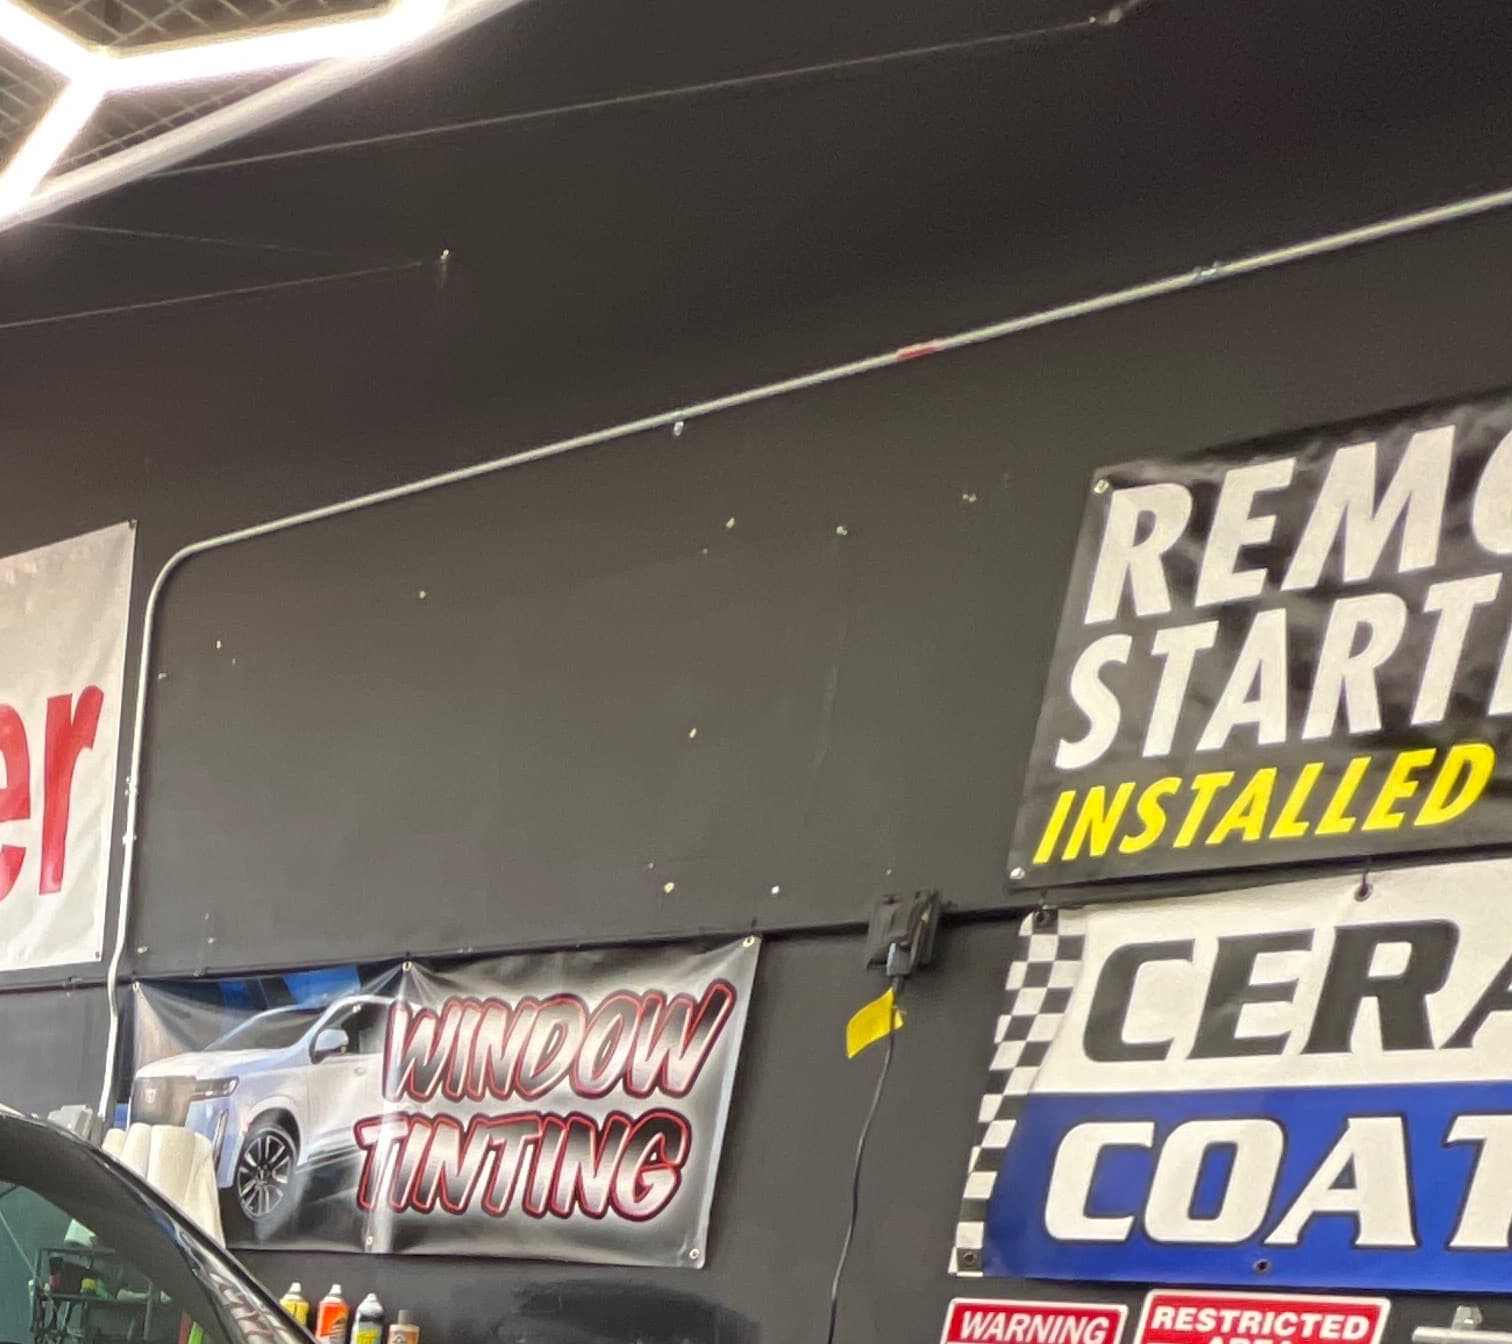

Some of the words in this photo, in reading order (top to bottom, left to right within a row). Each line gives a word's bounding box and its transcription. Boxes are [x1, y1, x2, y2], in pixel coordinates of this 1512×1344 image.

[1054, 572, 1512, 770] START
[1032, 742, 1497, 865] INSTALLED
[381, 978, 735, 1103] WINDOW
[353, 1105, 693, 1222] TINTING
[1150, 1305, 1370, 1341] RESTRICTED
